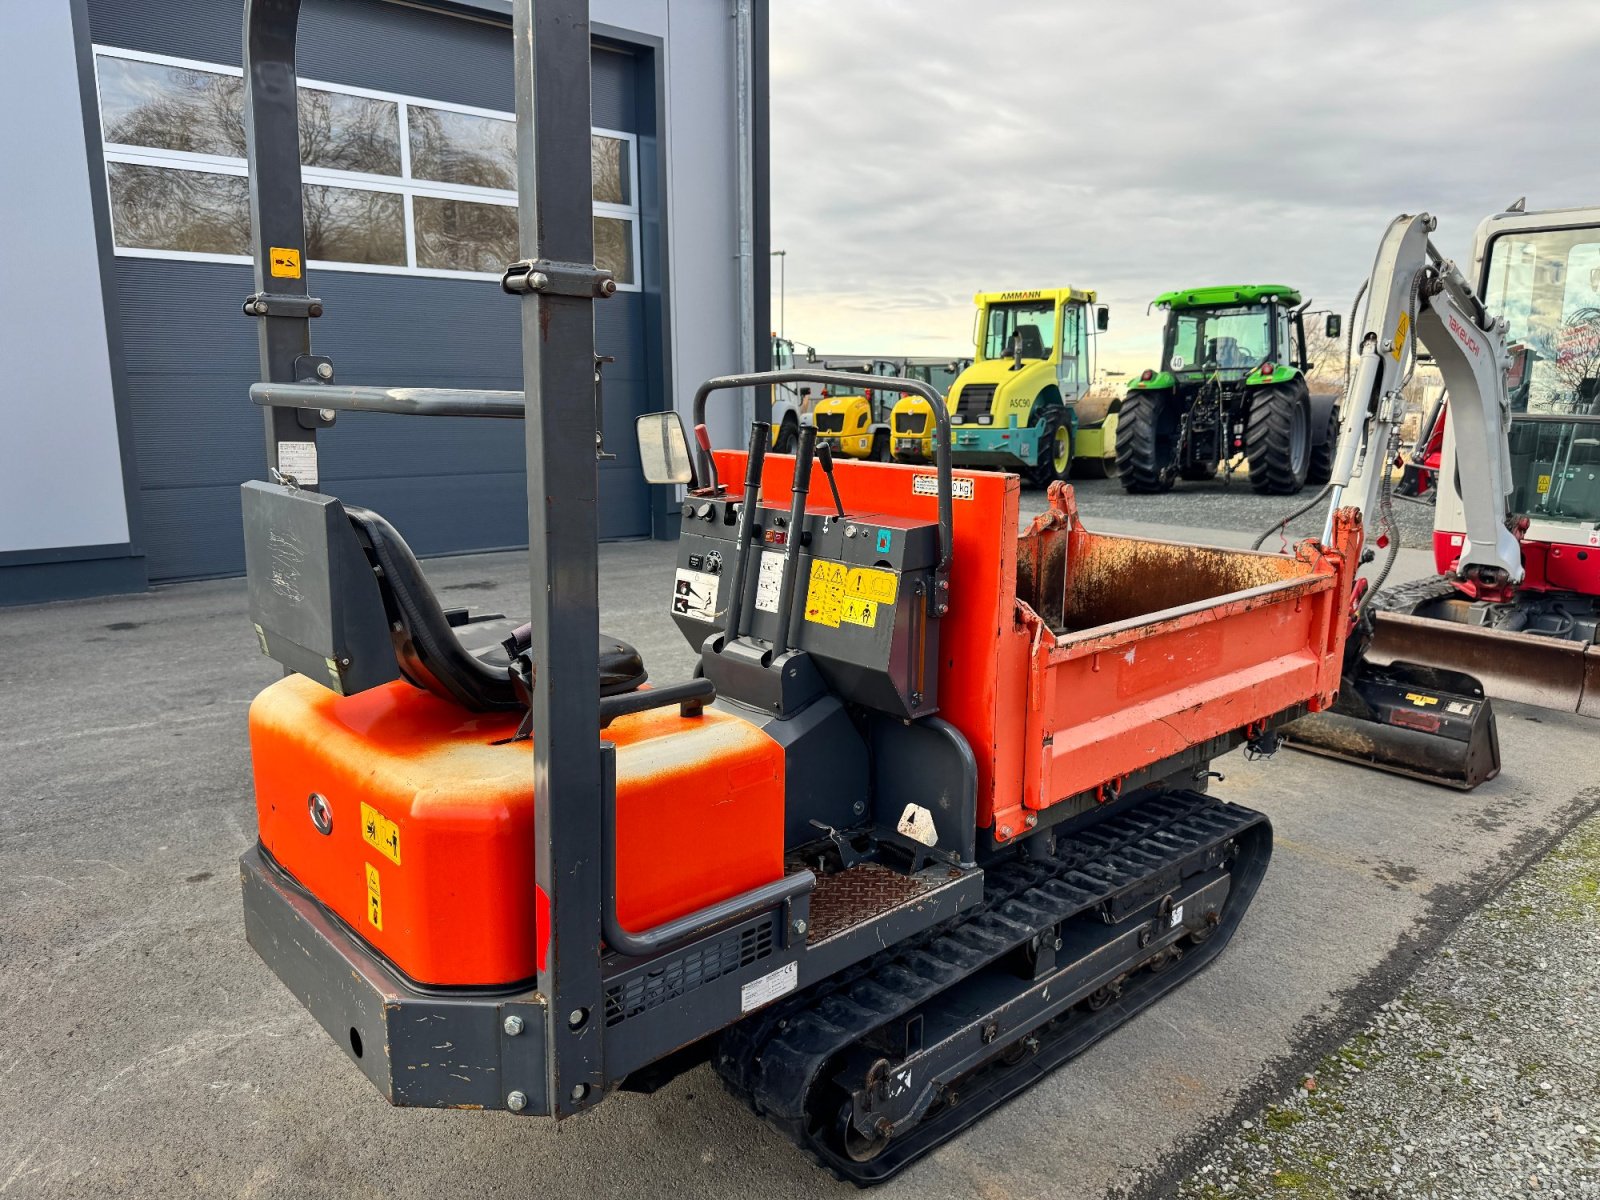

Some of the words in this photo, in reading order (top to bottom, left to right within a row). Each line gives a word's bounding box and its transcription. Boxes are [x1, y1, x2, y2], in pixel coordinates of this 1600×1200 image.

[1000, 290, 1041, 300] AMMANN
[1173, 358, 1182, 367] 40
[1010, 398, 1030, 408] ASC90
[959, 482, 969, 495] kg
